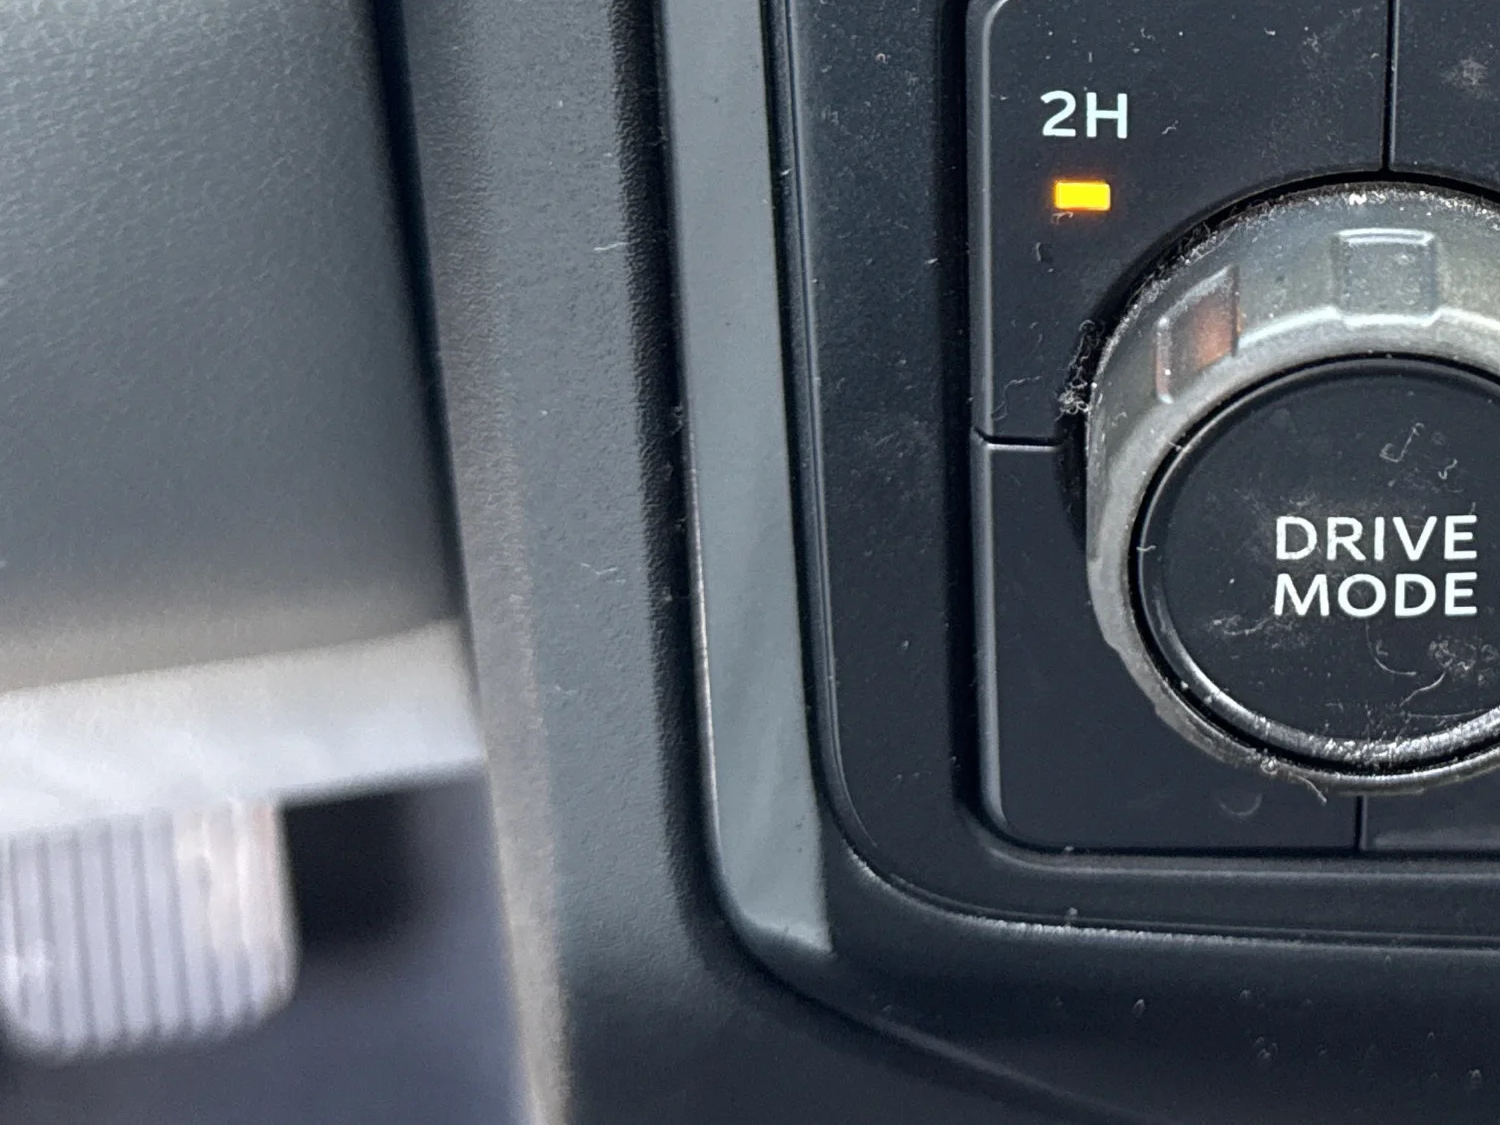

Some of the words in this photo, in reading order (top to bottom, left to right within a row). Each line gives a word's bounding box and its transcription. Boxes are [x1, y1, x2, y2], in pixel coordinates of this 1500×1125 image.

[1038, 89, 1129, 141] 2H
[1274, 512, 1479, 563] DRIVE
[1270, 570, 1479, 619] MODE
